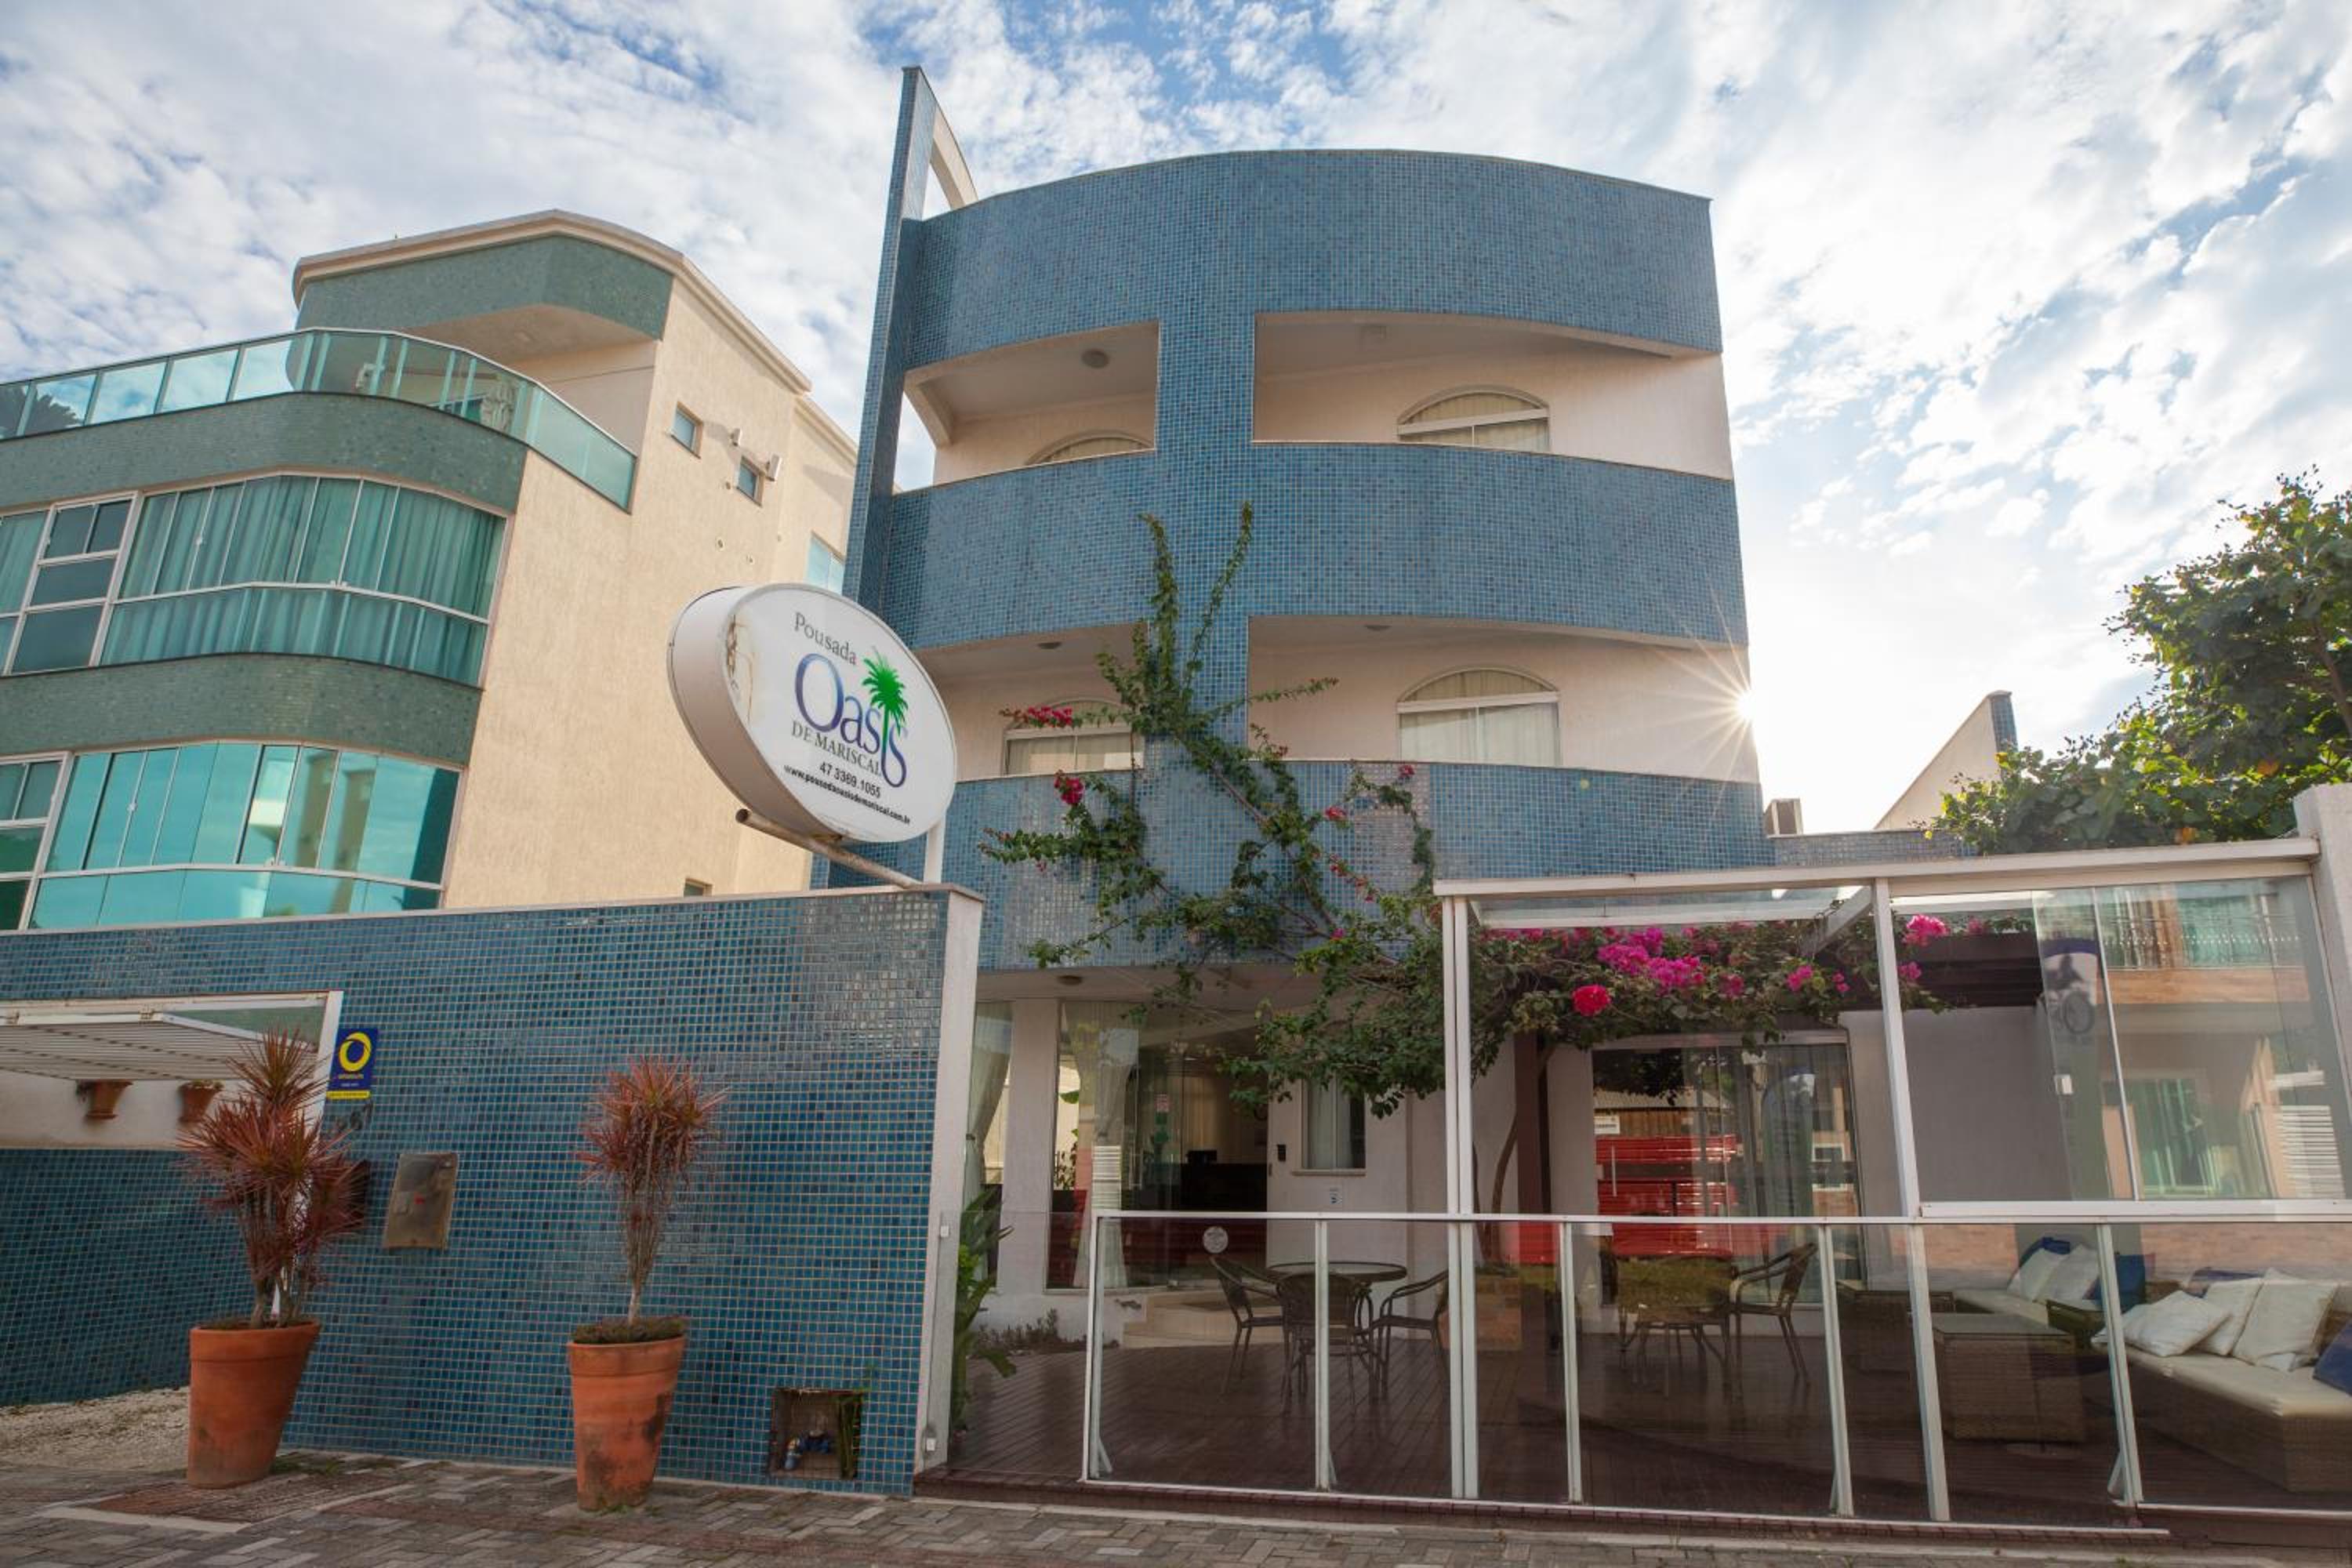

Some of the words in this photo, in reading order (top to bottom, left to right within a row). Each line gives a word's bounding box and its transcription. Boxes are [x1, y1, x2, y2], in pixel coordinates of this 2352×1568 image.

[795, 612, 857, 666] Pousada
[794, 652, 908, 788] Oasis
[791, 720, 812, 742] DE
[814, 731, 882, 777] MARISCAL
[819, 761, 833, 776] 47
